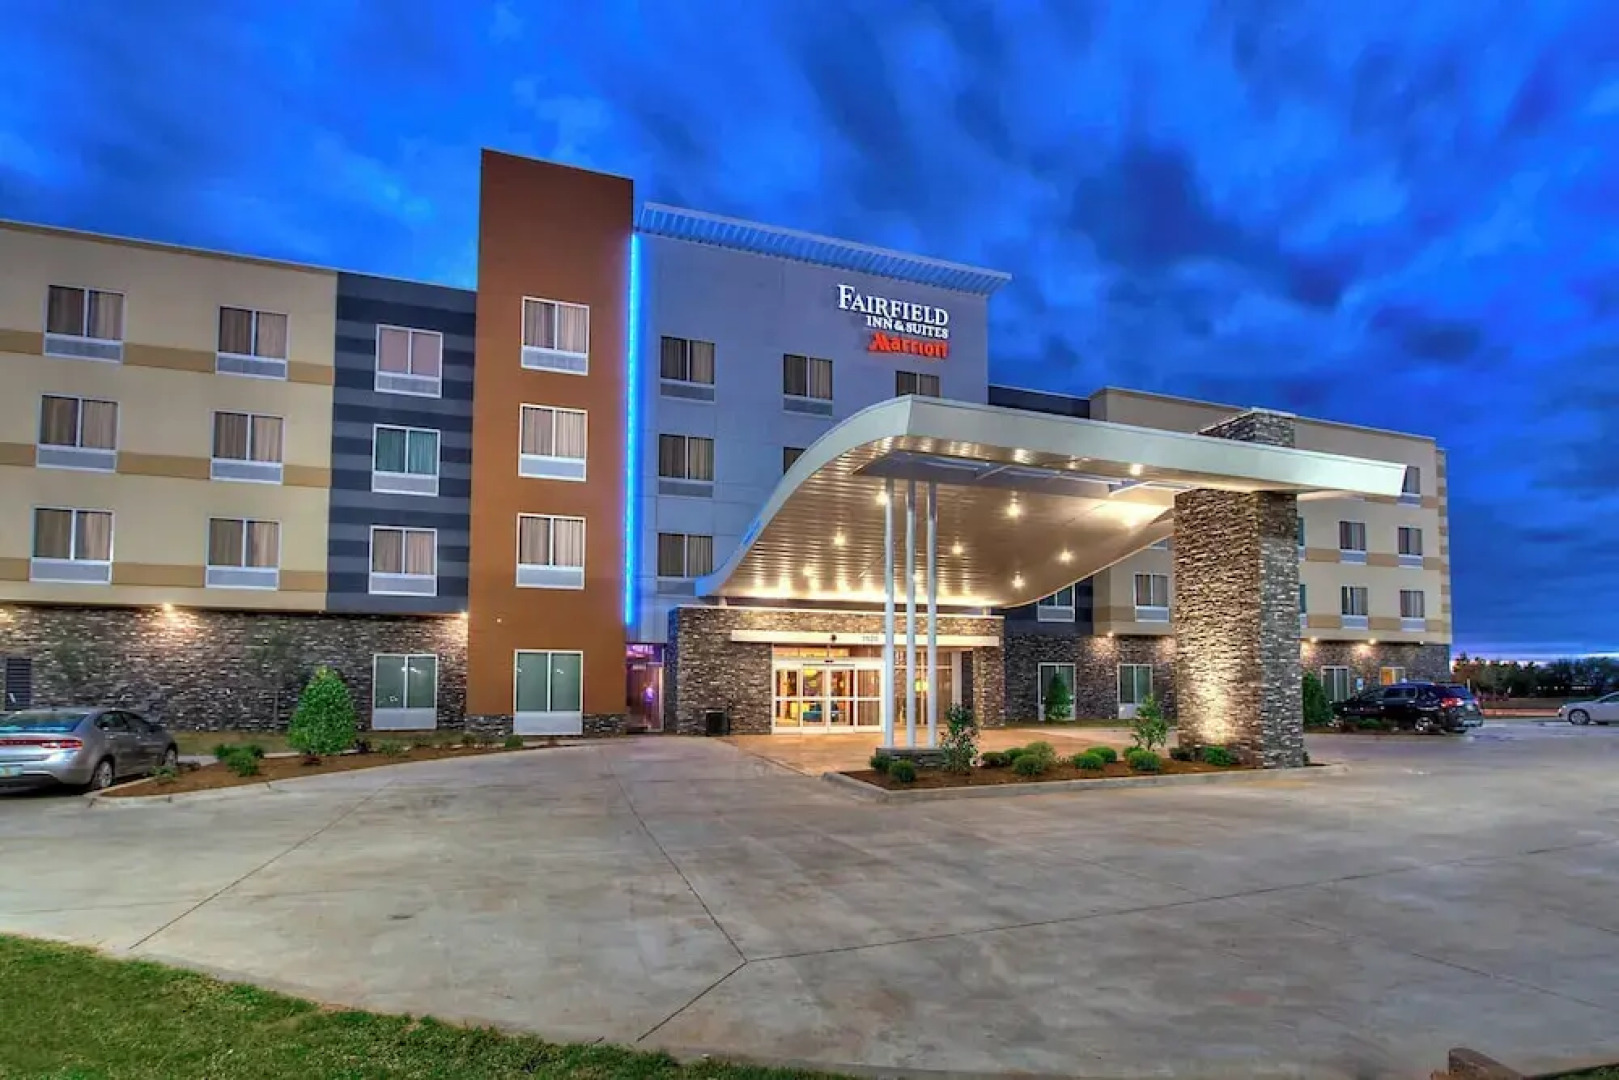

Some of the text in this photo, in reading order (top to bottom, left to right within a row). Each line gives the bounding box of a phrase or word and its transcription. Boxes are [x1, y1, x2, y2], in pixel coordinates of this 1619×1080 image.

[838, 284, 949, 326] FAIRFIELD
[906, 322, 949, 339] SUITES
[868, 331, 949, 359] Marriott
